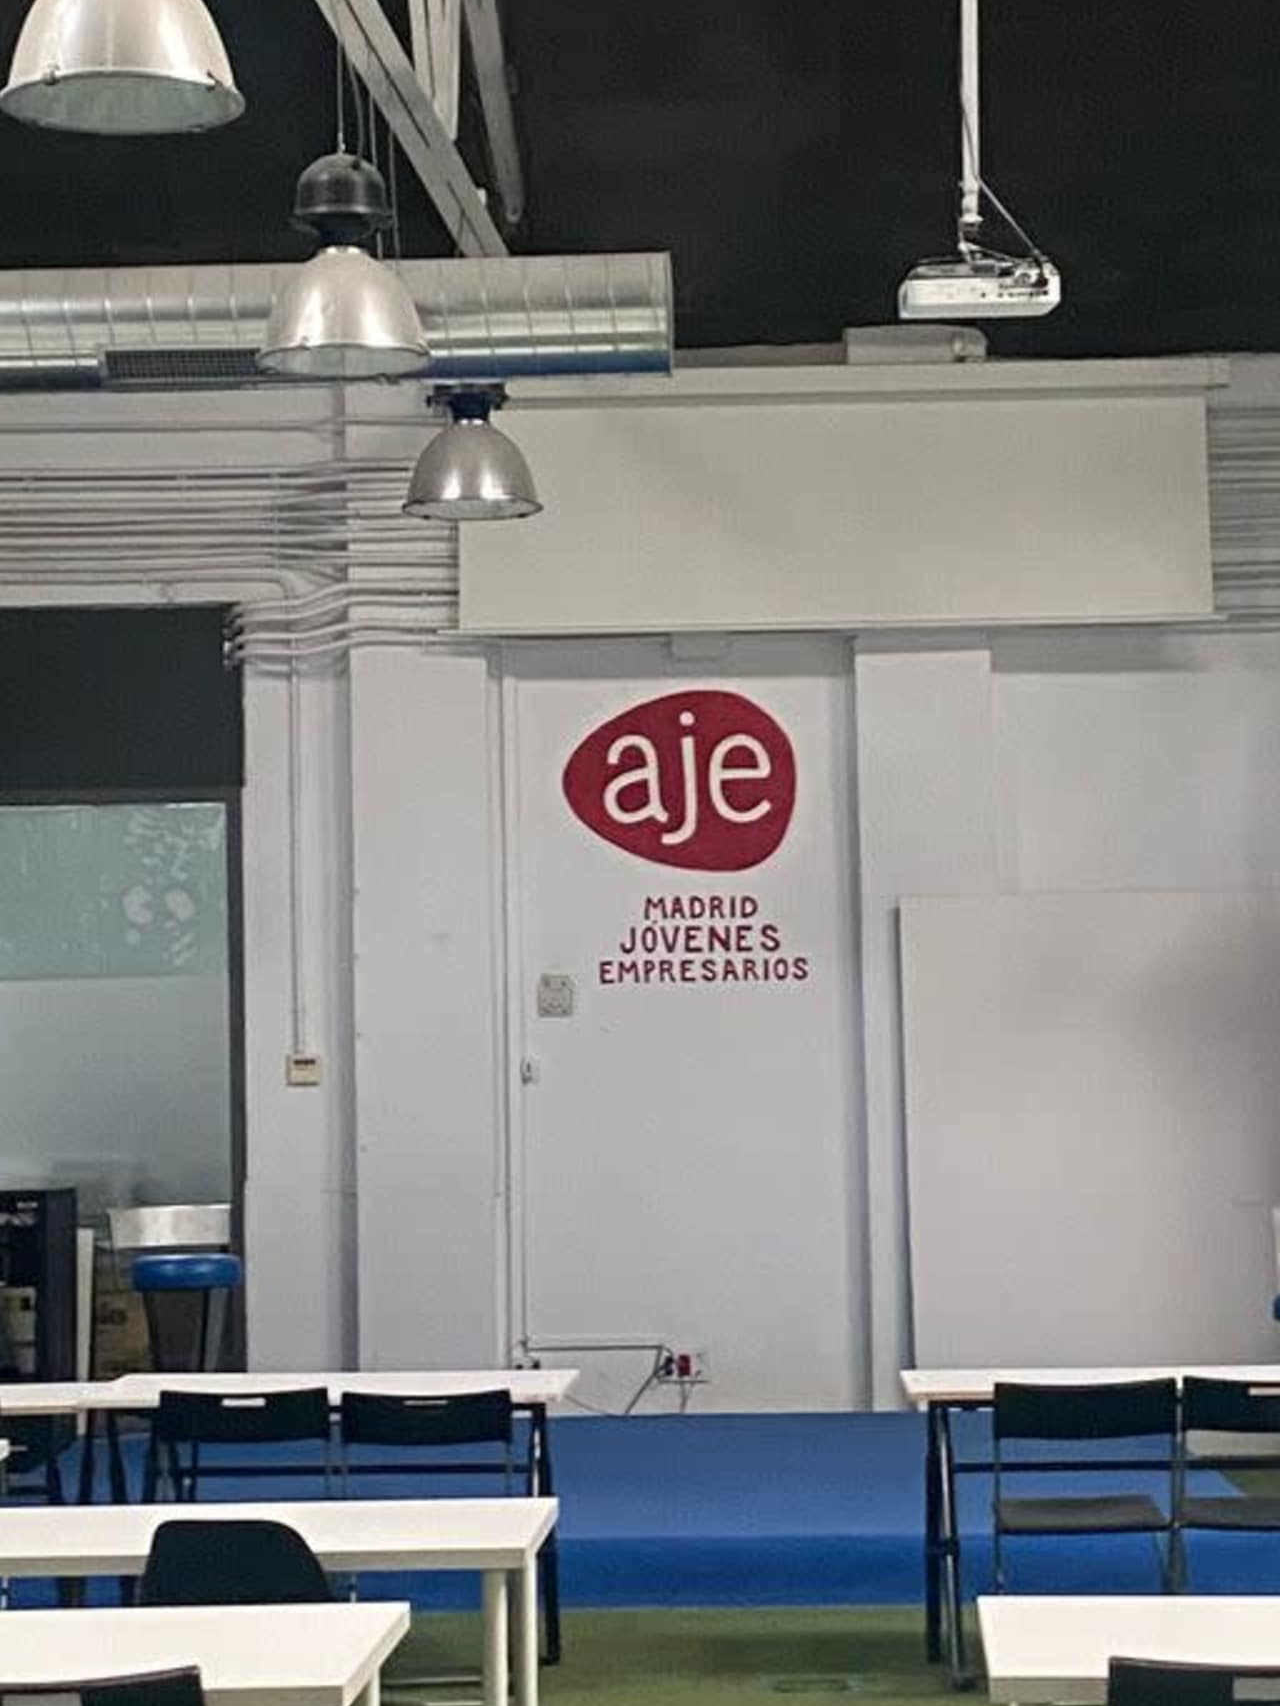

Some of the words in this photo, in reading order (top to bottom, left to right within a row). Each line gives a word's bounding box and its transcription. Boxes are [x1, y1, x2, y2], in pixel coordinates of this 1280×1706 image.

[601, 711, 772, 846] aje
[644, 896, 759, 920] MADRID
[599, 957, 809, 985] EMPRESARIOS
